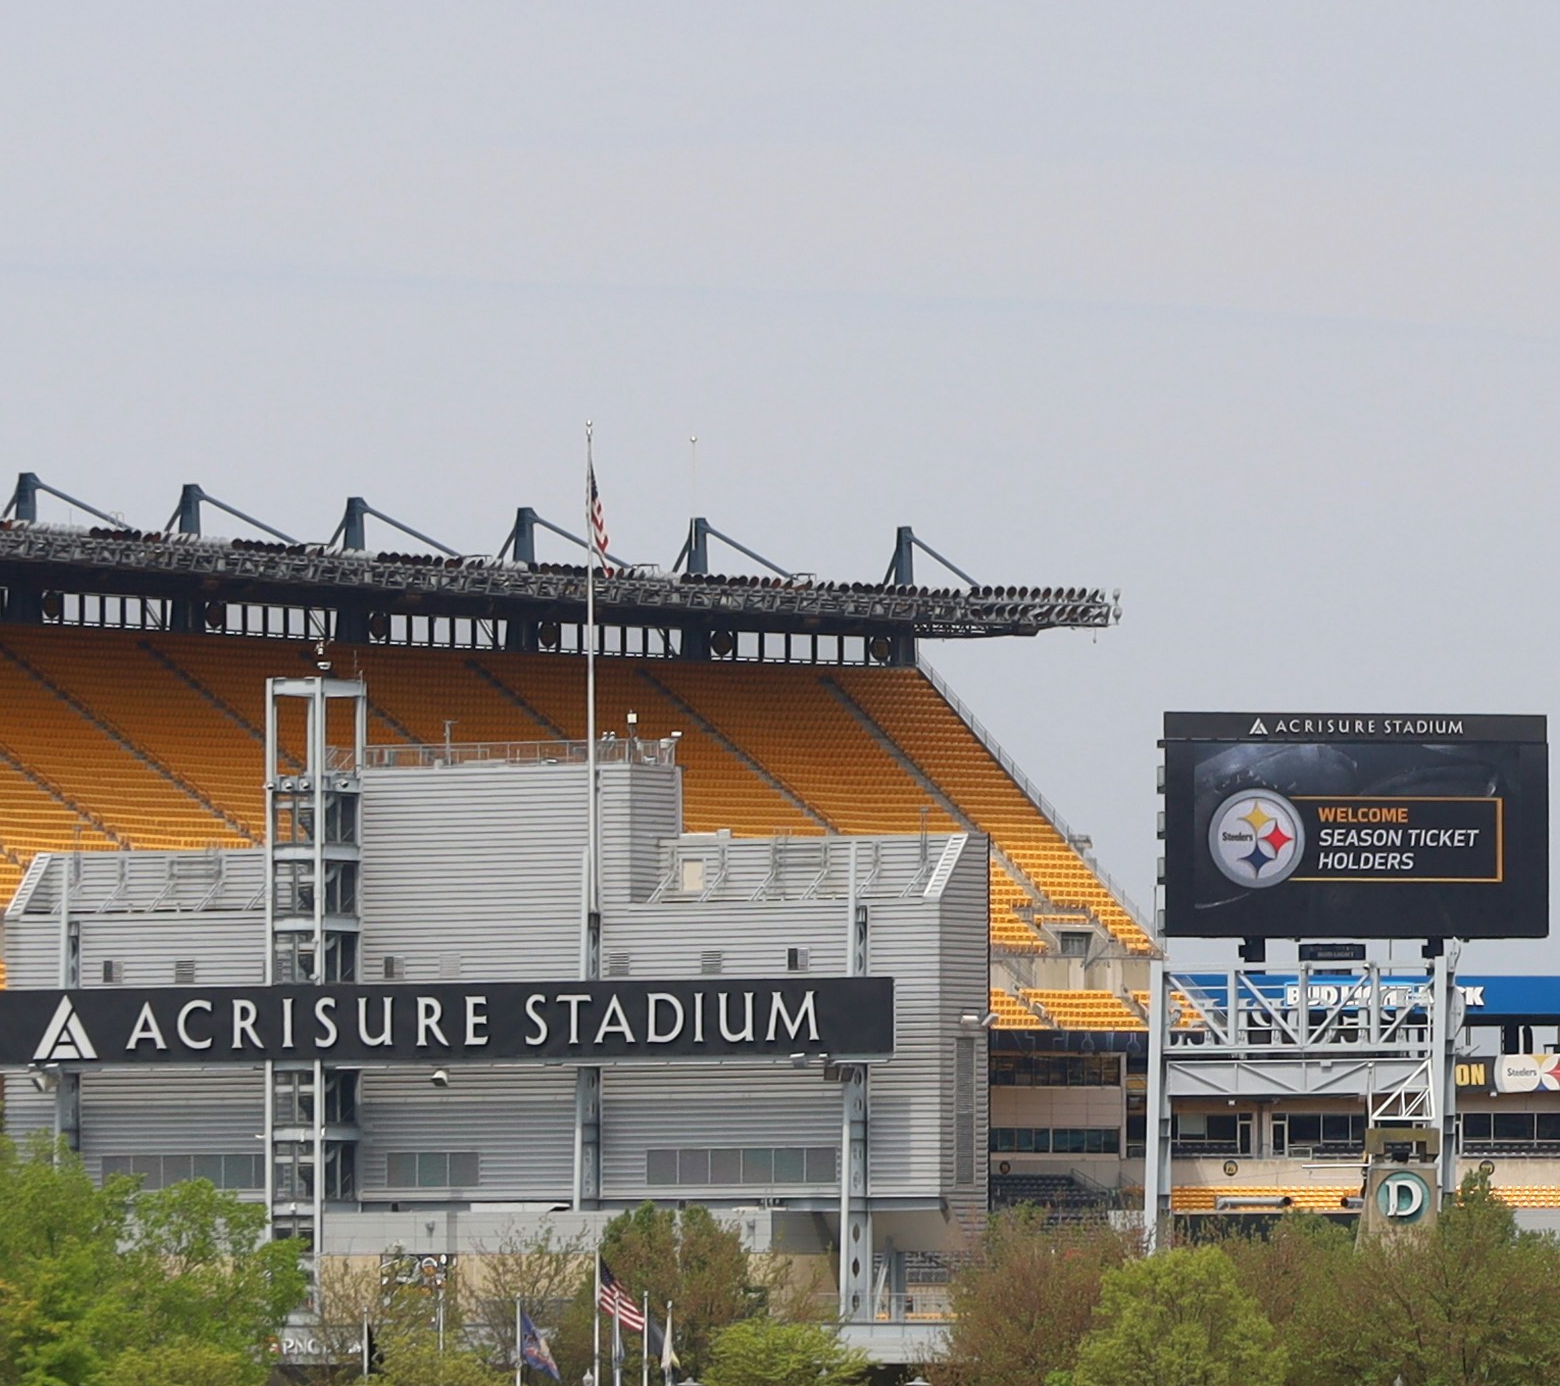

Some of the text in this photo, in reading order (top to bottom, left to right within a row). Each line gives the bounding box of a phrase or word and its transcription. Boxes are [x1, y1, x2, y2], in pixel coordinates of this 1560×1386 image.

[1275, 719, 1464, 734] ACRISURE STADIUM
[1318, 807, 1409, 824] WELCOME
[1222, 831, 1253, 842] Steelers
[1318, 829, 1480, 848] SEASON TICKET
[1318, 852, 1414, 870] HOLDERS
[1287, 986, 1338, 1006] BUD
[125, 990, 821, 1050] ACRISURE STADIUM
[1506, 1066, 1538, 1078] Steelers
[1385, 1179, 1423, 1216] D
